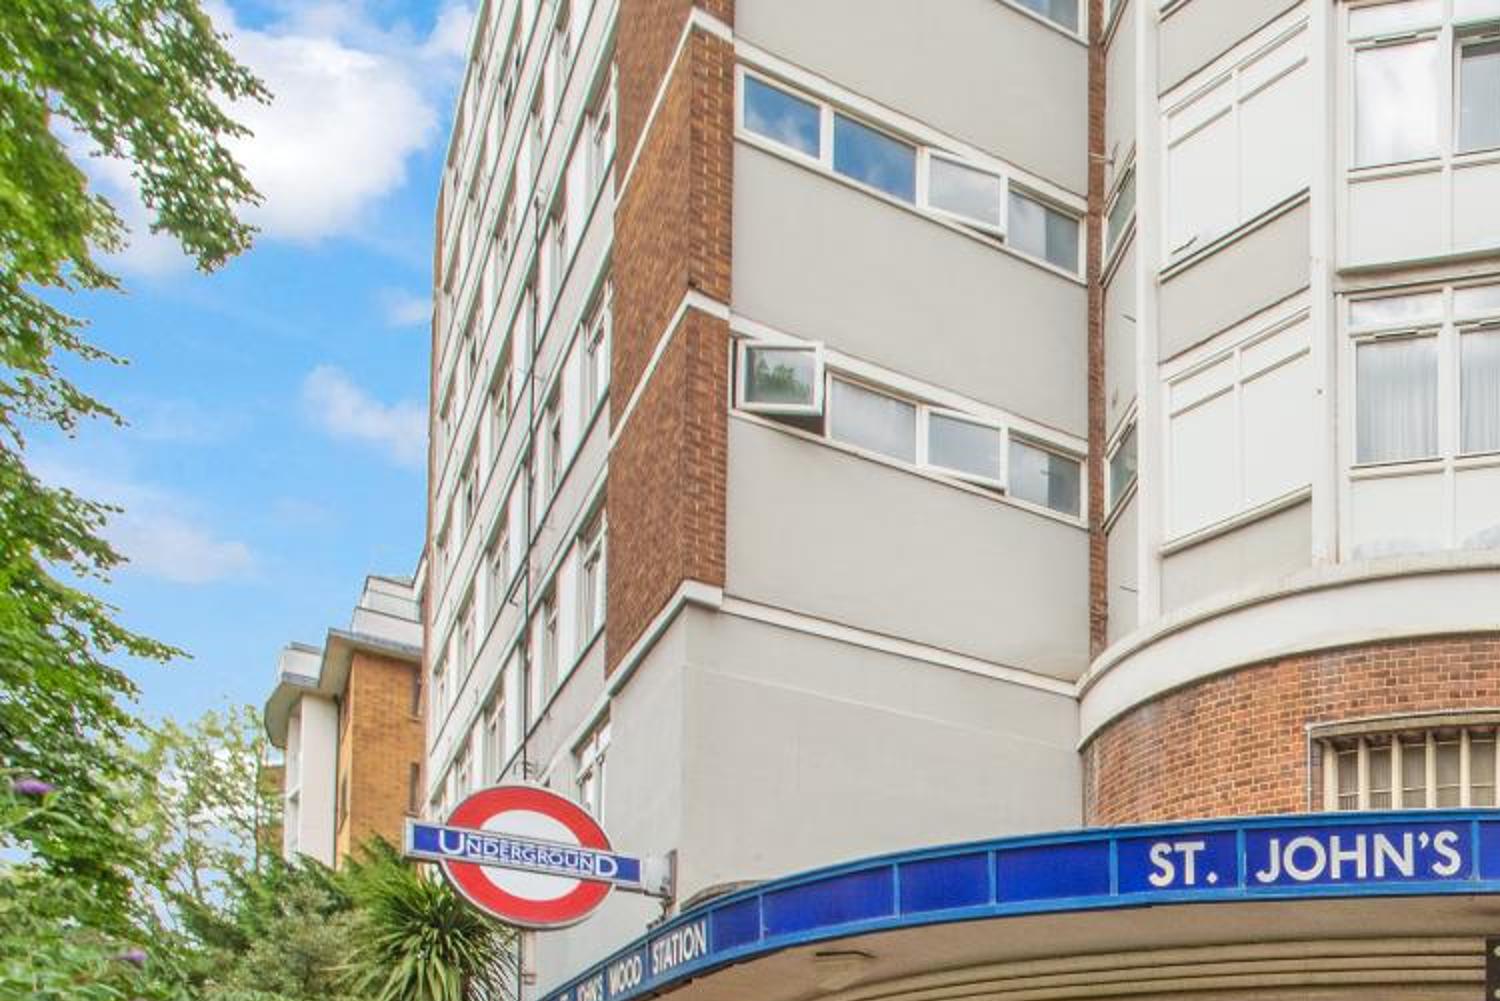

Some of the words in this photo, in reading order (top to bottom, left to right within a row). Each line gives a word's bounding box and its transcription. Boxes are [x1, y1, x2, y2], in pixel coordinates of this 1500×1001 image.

[438, 829, 618, 877] UNDERGROUND
[1148, 841, 1218, 887] ST.
[1255, 831, 1462, 884] JOHN'S
[609, 955, 643, 997] WOOD
[652, 921, 707, 975] STATION
